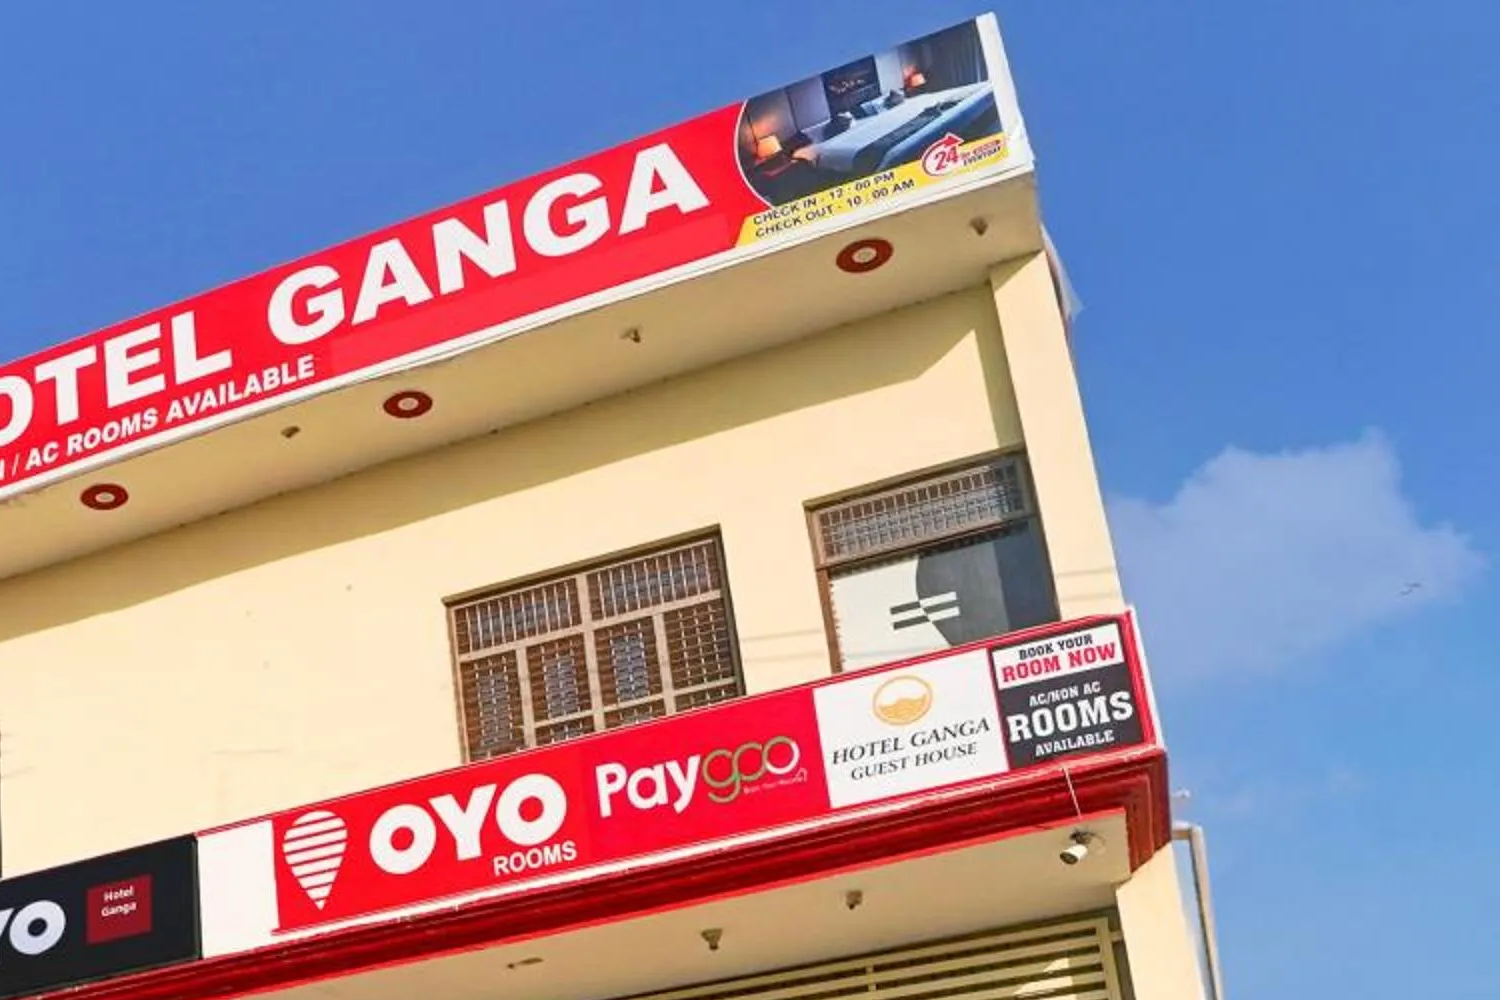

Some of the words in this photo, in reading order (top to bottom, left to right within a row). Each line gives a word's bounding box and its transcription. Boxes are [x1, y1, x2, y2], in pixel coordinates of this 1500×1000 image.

[753, 203, 799, 226] CHECK
[804, 197, 817, 208] IN
[829, 188, 844, 200] 12
[873, 172, 896, 186] PM
[755, 217, 802, 238] CHECK
[805, 206, 834, 222] OUT
[847, 195, 861, 208] 10
[892, 179, 915, 193] AM
[267, 143, 710, 345] GANGA
[24, 441, 60, 471] AC
[67, 408, 159, 457] ROOMS
[165, 353, 316, 423] AVAILABLE
[1001, 655, 1061, 683] ROOM
[1068, 642, 1116, 669] NOW
[1018, 643, 1054, 661] BOOK
[1057, 633, 1093, 652] YOUR
[1029, 686, 1079, 707] AC/NON
[1083, 681, 1101, 696] AC
[1006, 691, 1134, 743] ROOMS
[832, 737, 904, 765] HOTEL
[910, 717, 990, 748] GANGA
[851, 756, 910, 781] GUEST
[915, 742, 977, 767] HOUSE
[1035, 729, 1115, 757] AVAILABLE
[369, 773, 568, 875] OYO
[493, 840, 577, 877] ROOMS
[101, 902, 137, 917] Ganga
[103, 885, 134, 902] Hotel
